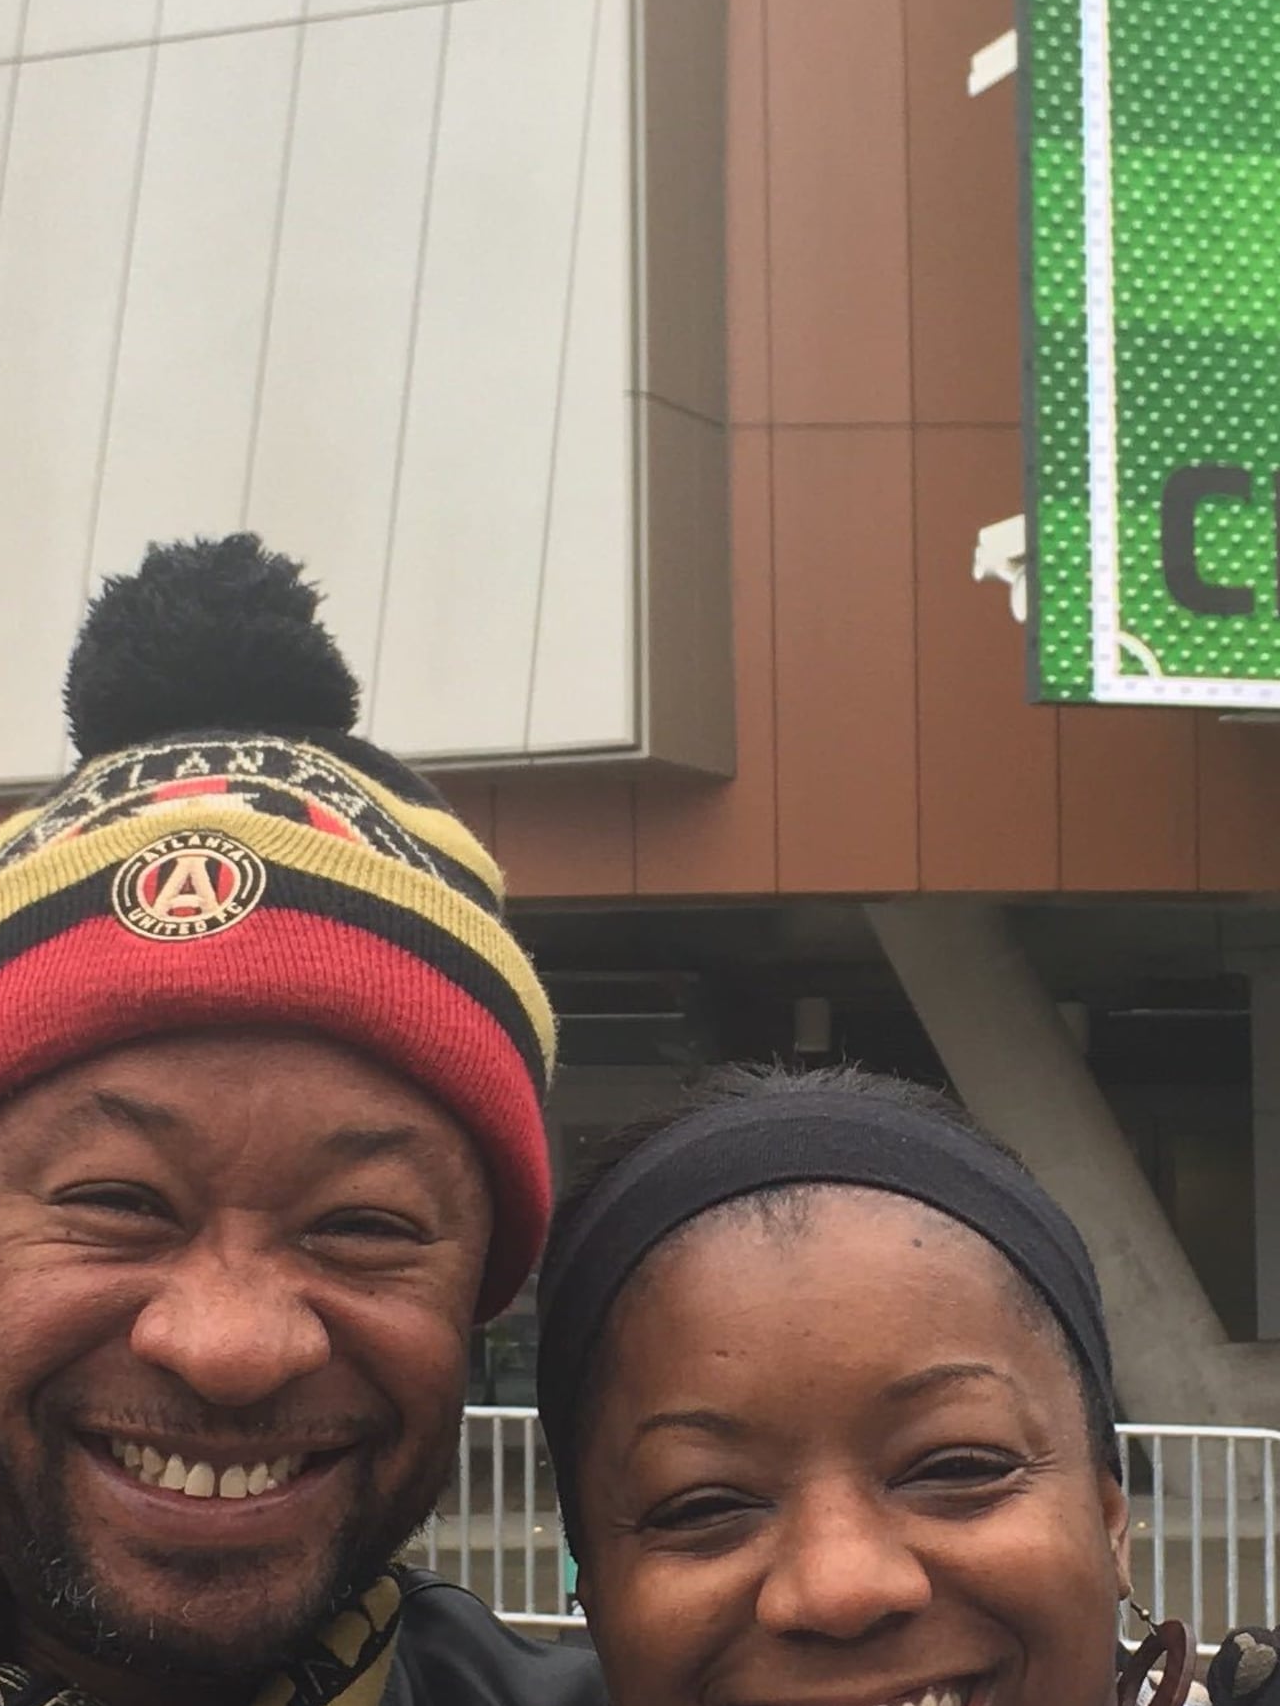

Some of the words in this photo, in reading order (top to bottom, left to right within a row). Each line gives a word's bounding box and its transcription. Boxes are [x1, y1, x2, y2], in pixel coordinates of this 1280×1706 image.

[141, 834, 246, 863] ATLANTA
[127, 906, 208, 936] UNITED
[214, 901, 244, 925] FC
